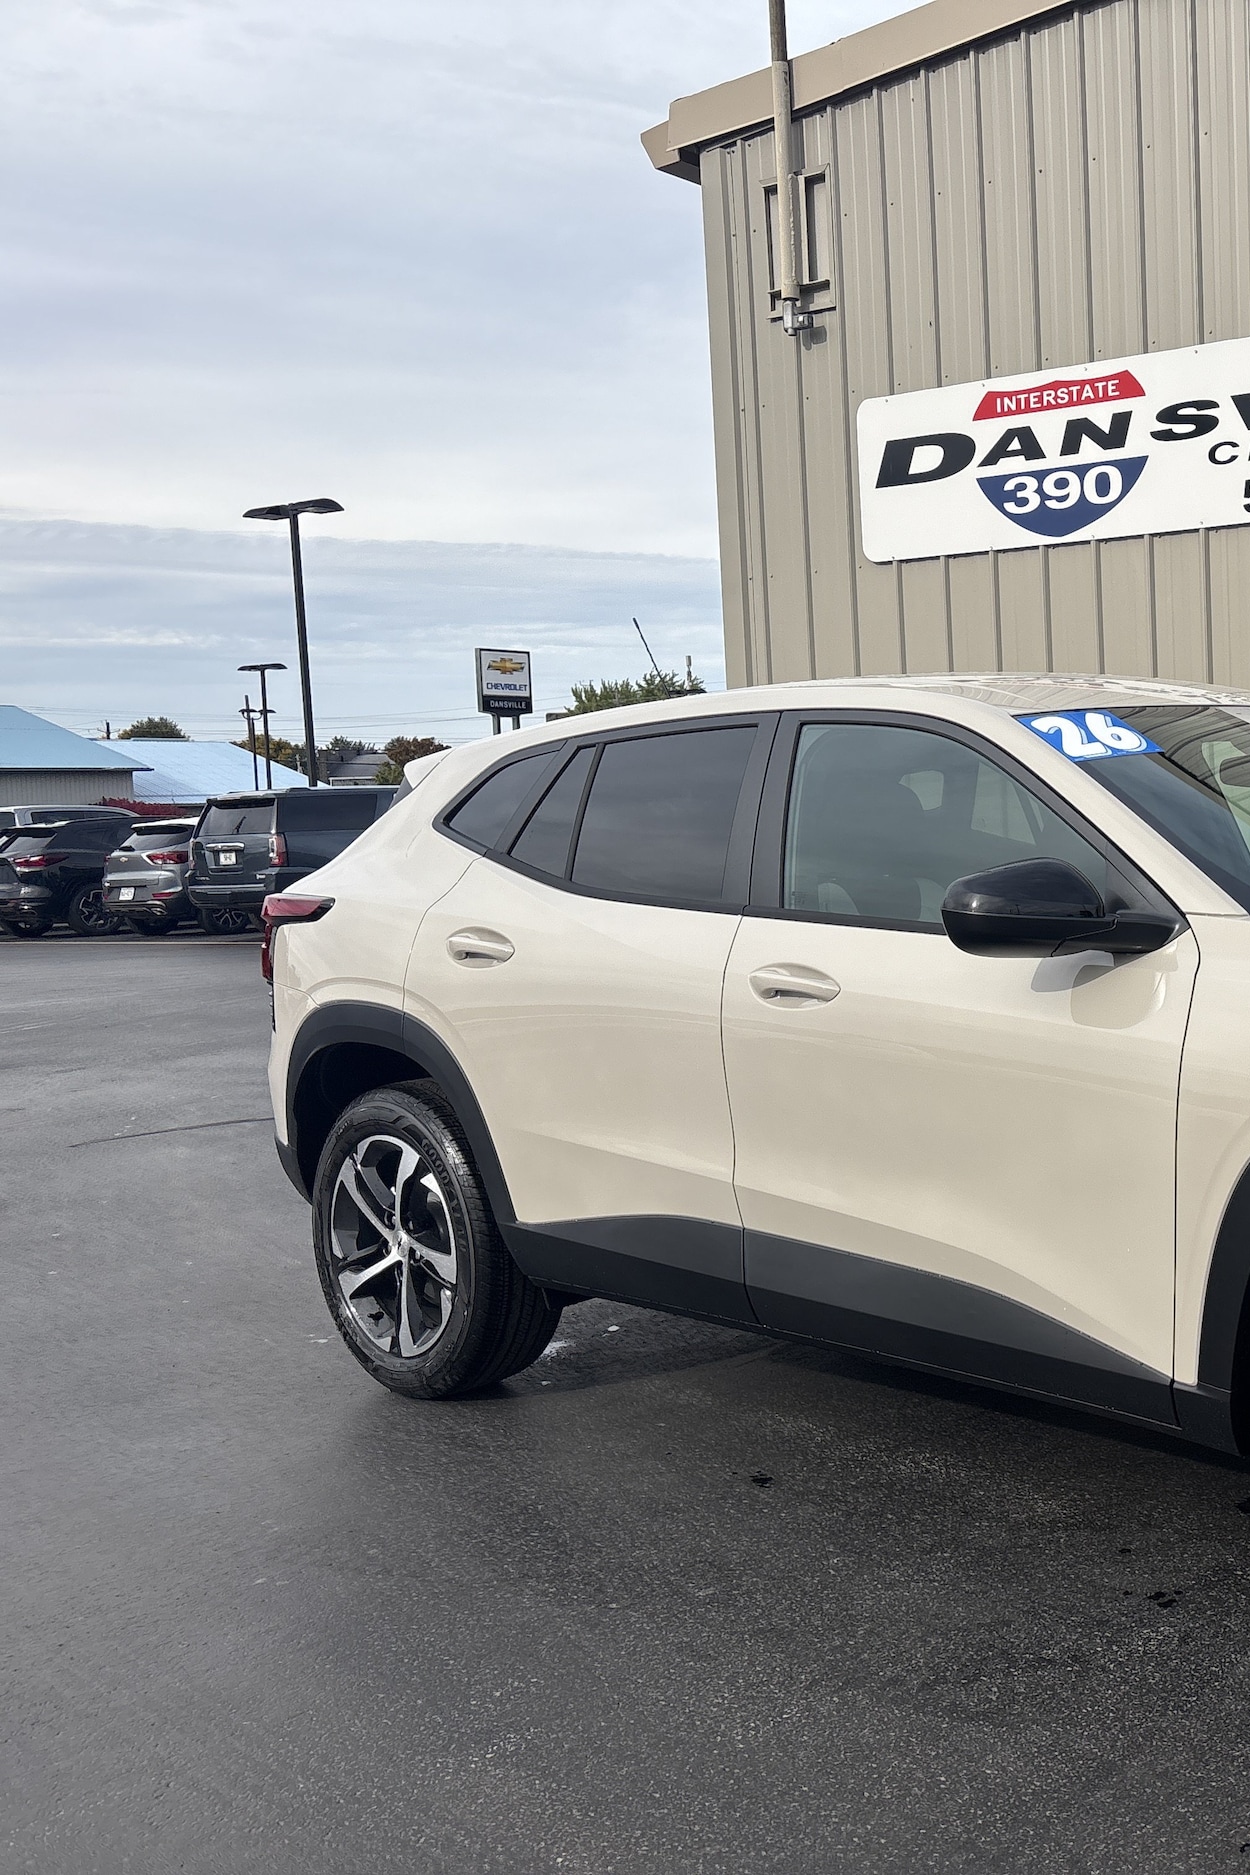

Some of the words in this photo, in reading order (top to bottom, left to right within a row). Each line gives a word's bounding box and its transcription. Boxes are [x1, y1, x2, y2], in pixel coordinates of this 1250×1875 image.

[995, 380, 1121, 413] INTERSTATE
[1002, 466, 1123, 514] 390
[486, 682, 528, 692] CHEVROLET
[490, 700, 527, 709] DANSVILLE
[1030, 712, 1148, 758] 26
